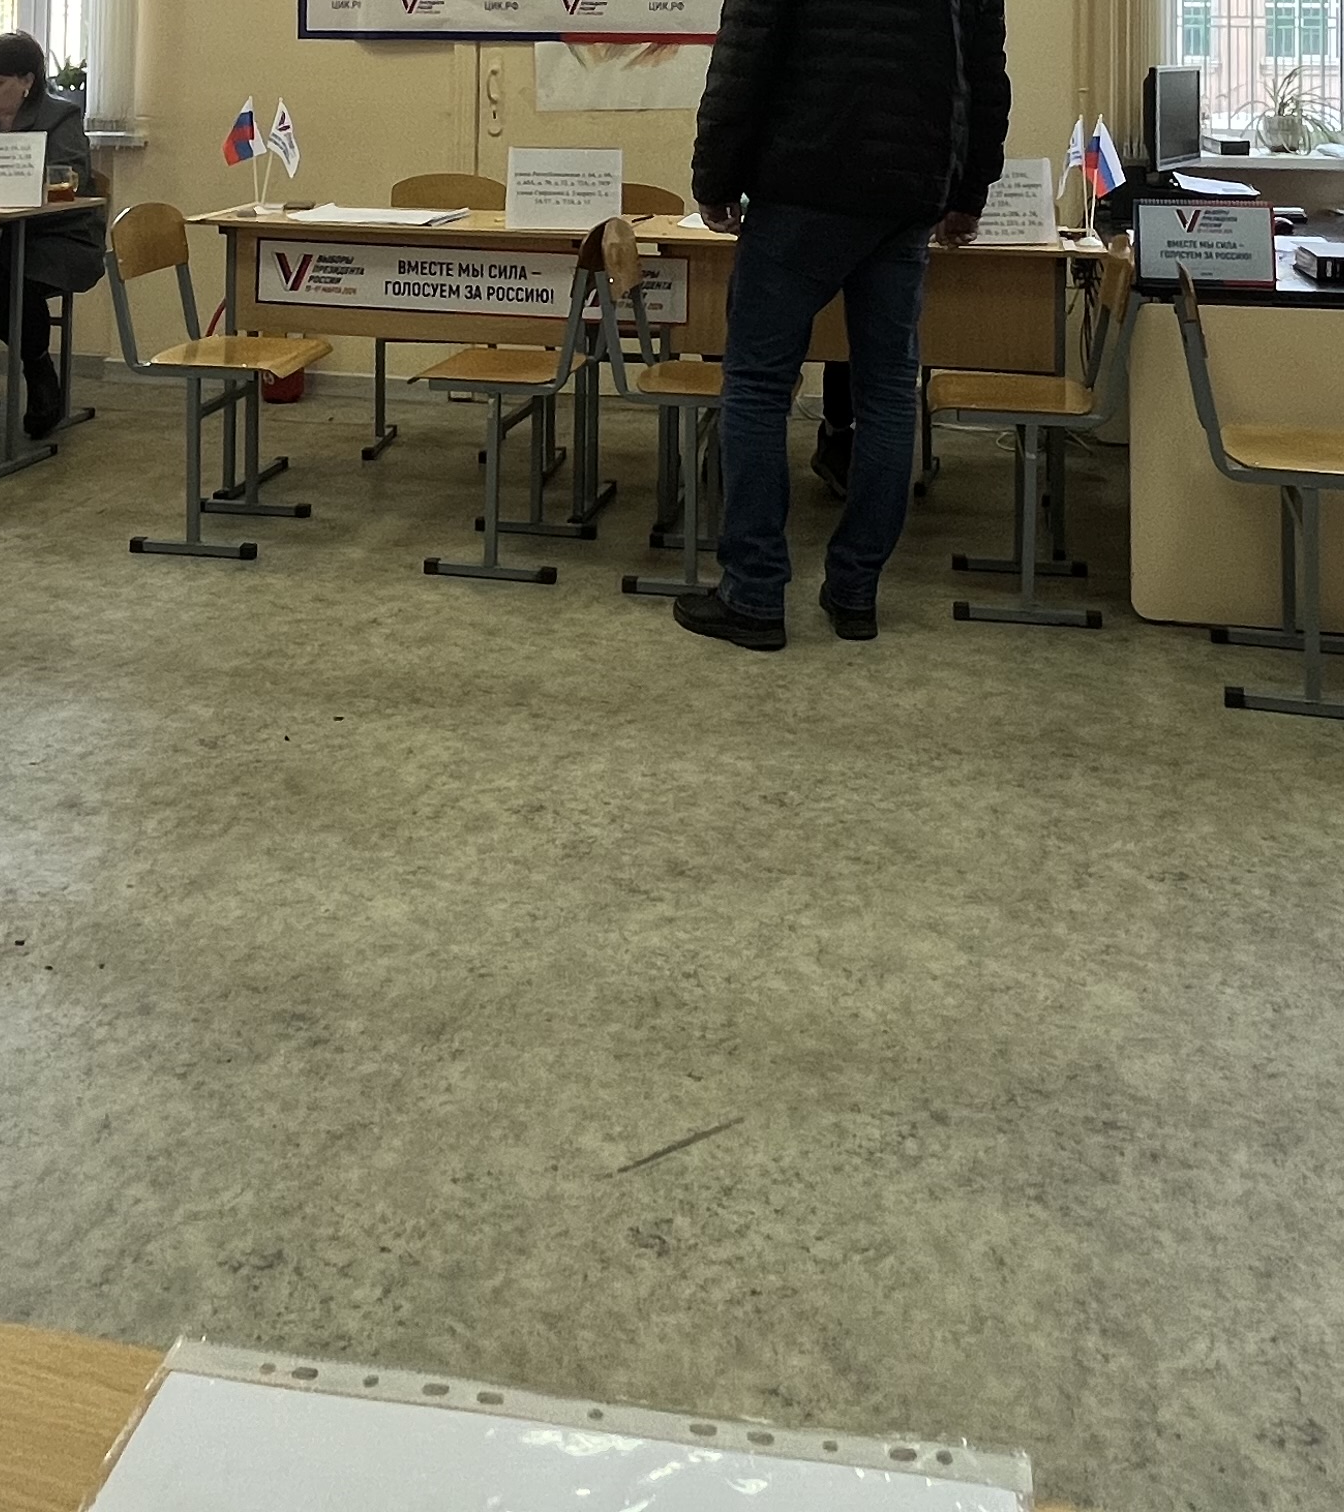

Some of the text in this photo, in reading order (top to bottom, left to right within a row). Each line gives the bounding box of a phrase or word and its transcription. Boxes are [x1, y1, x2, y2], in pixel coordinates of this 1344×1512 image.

[398, 260, 454, 277] ВМЕСТЕ
[458, 262, 484, 278] МЫ
[488, 264, 528, 280] СИЛА
[384, 281, 554, 304] ГОЛОСУЕМ ЗА РОССИЮ!
